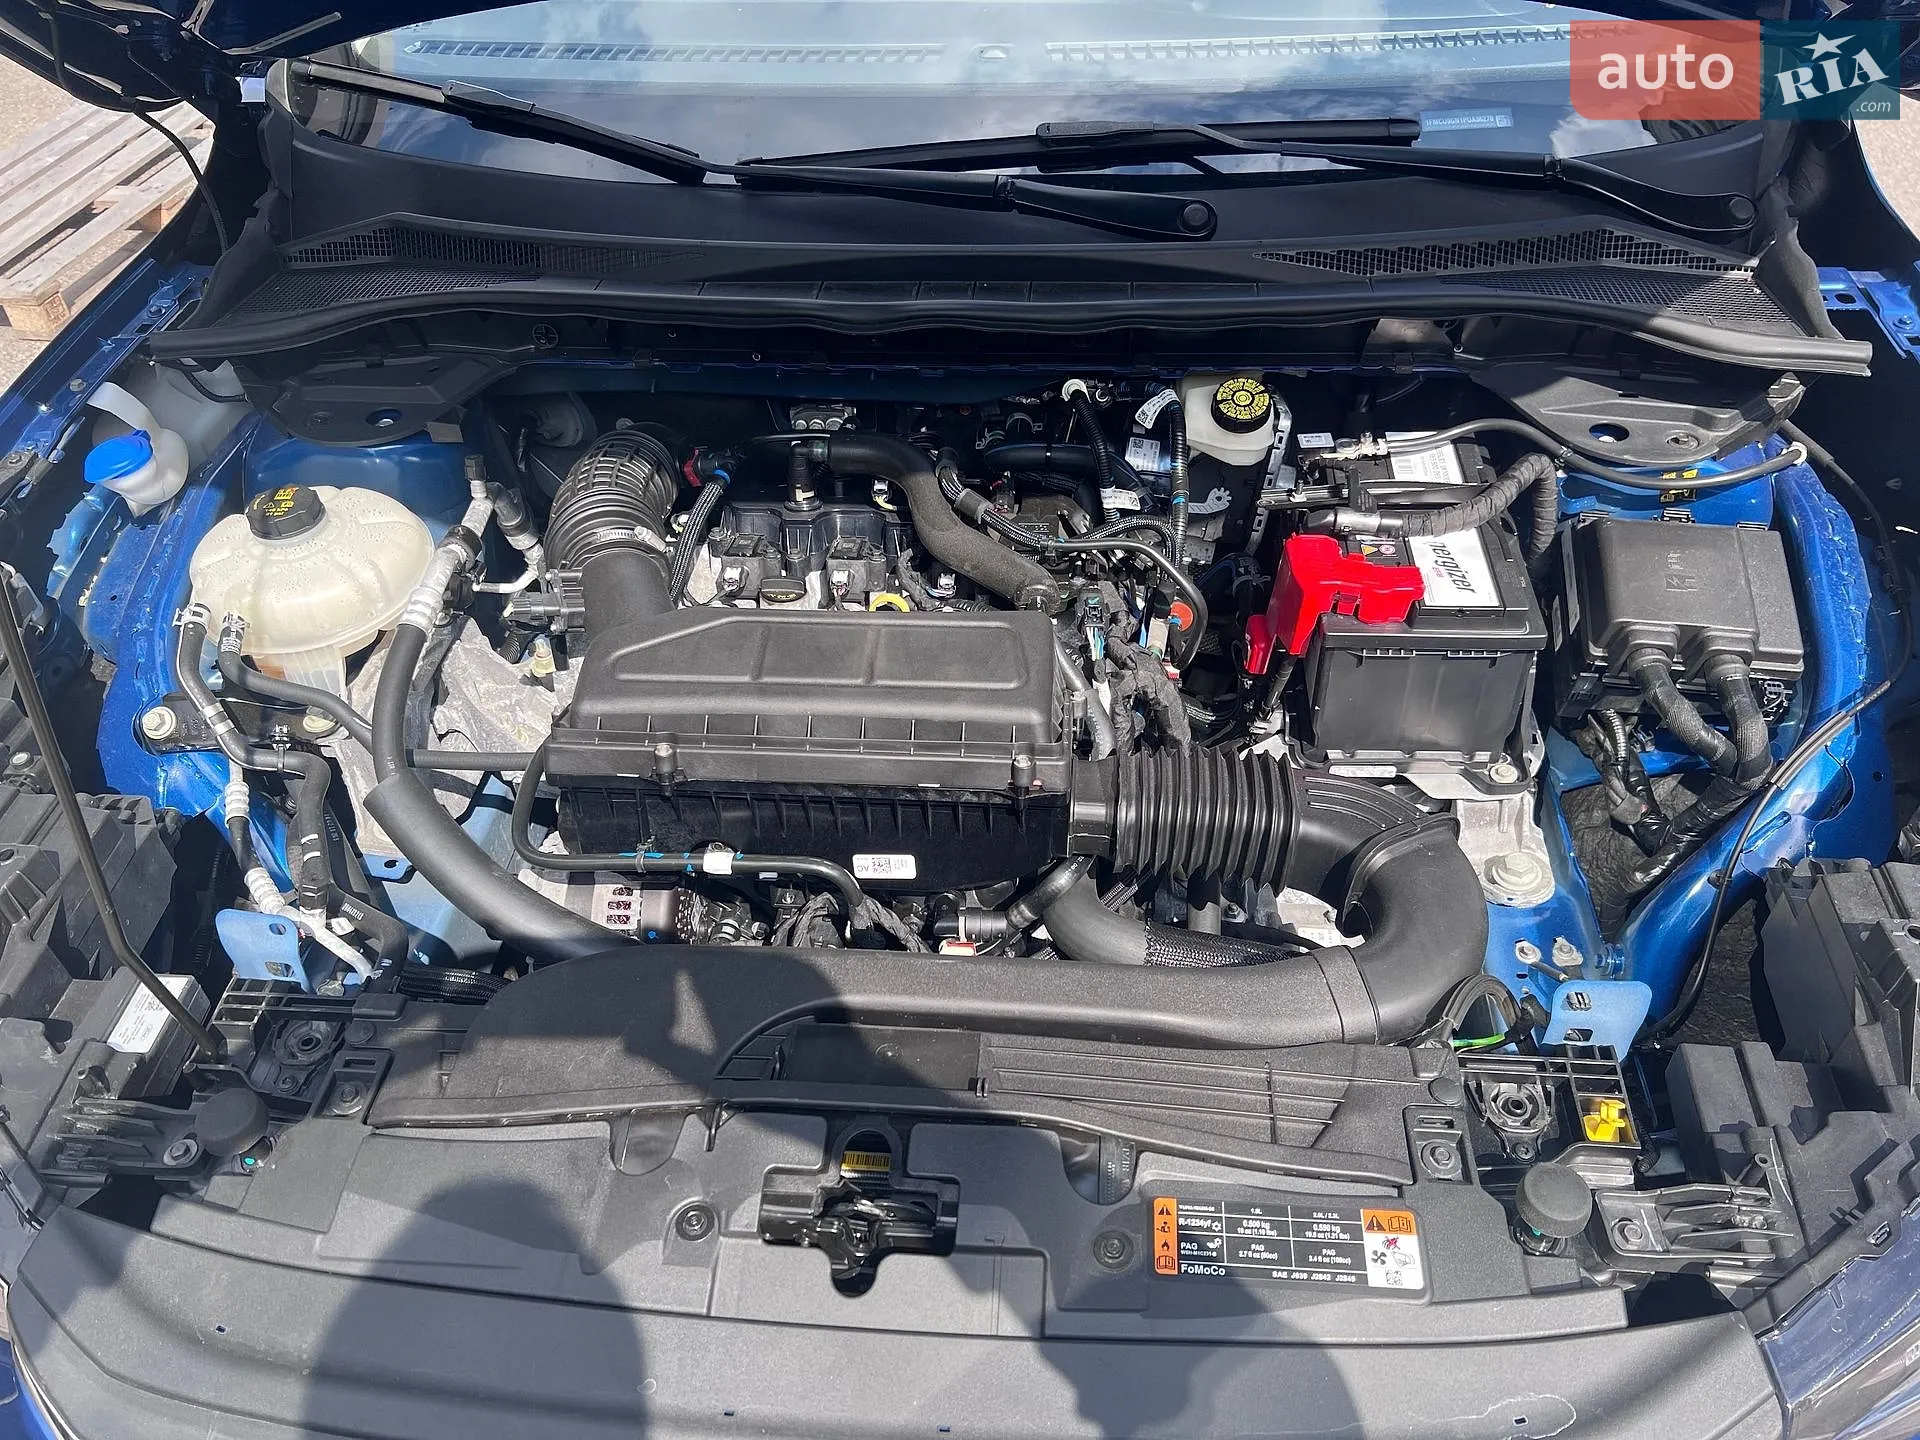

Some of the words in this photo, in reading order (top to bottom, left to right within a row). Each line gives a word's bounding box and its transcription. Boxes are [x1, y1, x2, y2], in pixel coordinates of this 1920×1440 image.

[1421, 541, 1477, 593] nergizer
[1181, 1242, 1198, 1250] PAG
[1251, 1244, 1264, 1252] PAG
[1322, 1248, 1336, 1256] PAG
[1181, 1263, 1226, 1276] FoMoCo
[1272, 1271, 1288, 1279] SAE
